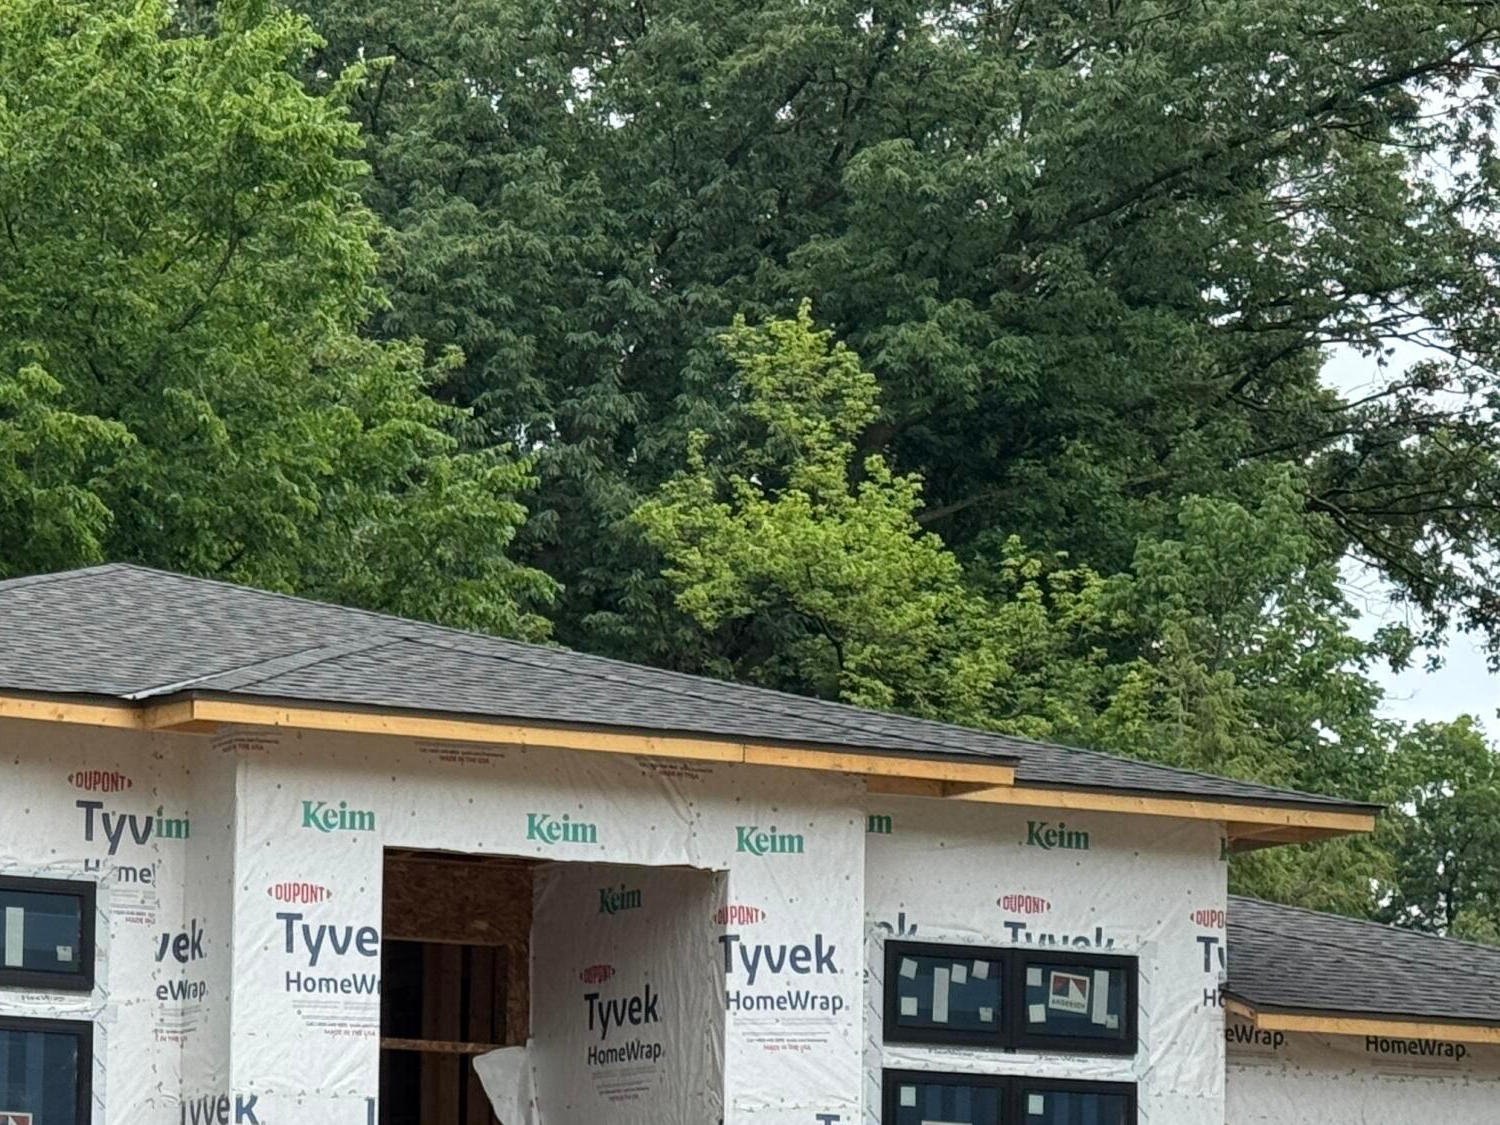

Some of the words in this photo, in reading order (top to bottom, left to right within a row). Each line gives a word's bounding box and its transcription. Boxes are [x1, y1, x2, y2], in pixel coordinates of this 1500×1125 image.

[75, 771, 126, 792] DUPONT
[76, 800, 154, 855] Tyv
[154, 805, 191, 839] im
[301, 801, 376, 832] Keim
[526, 812, 598, 844] Keim
[735, 825, 804, 856] Keim
[1026, 820, 1090, 850] Keim
[274, 883, 327, 903] DUPONT
[598, 883, 642, 913] Keim
[1002, 894, 1046, 914] DUPONT
[1196, 909, 1225, 928] DUPO
[276, 913, 379, 967] Tyve
[718, 934, 838, 986] Tyvek
[155, 979, 207, 1003] eWrap
[725, 990, 844, 1016] HomeWrap
[584, 984, 659, 1040] Tyvek
[1225, 1024, 1284, 1049] eWrap
[1365, 1034, 1466, 1060] HomeWrap
[587, 1041, 662, 1066] HomeWrap
